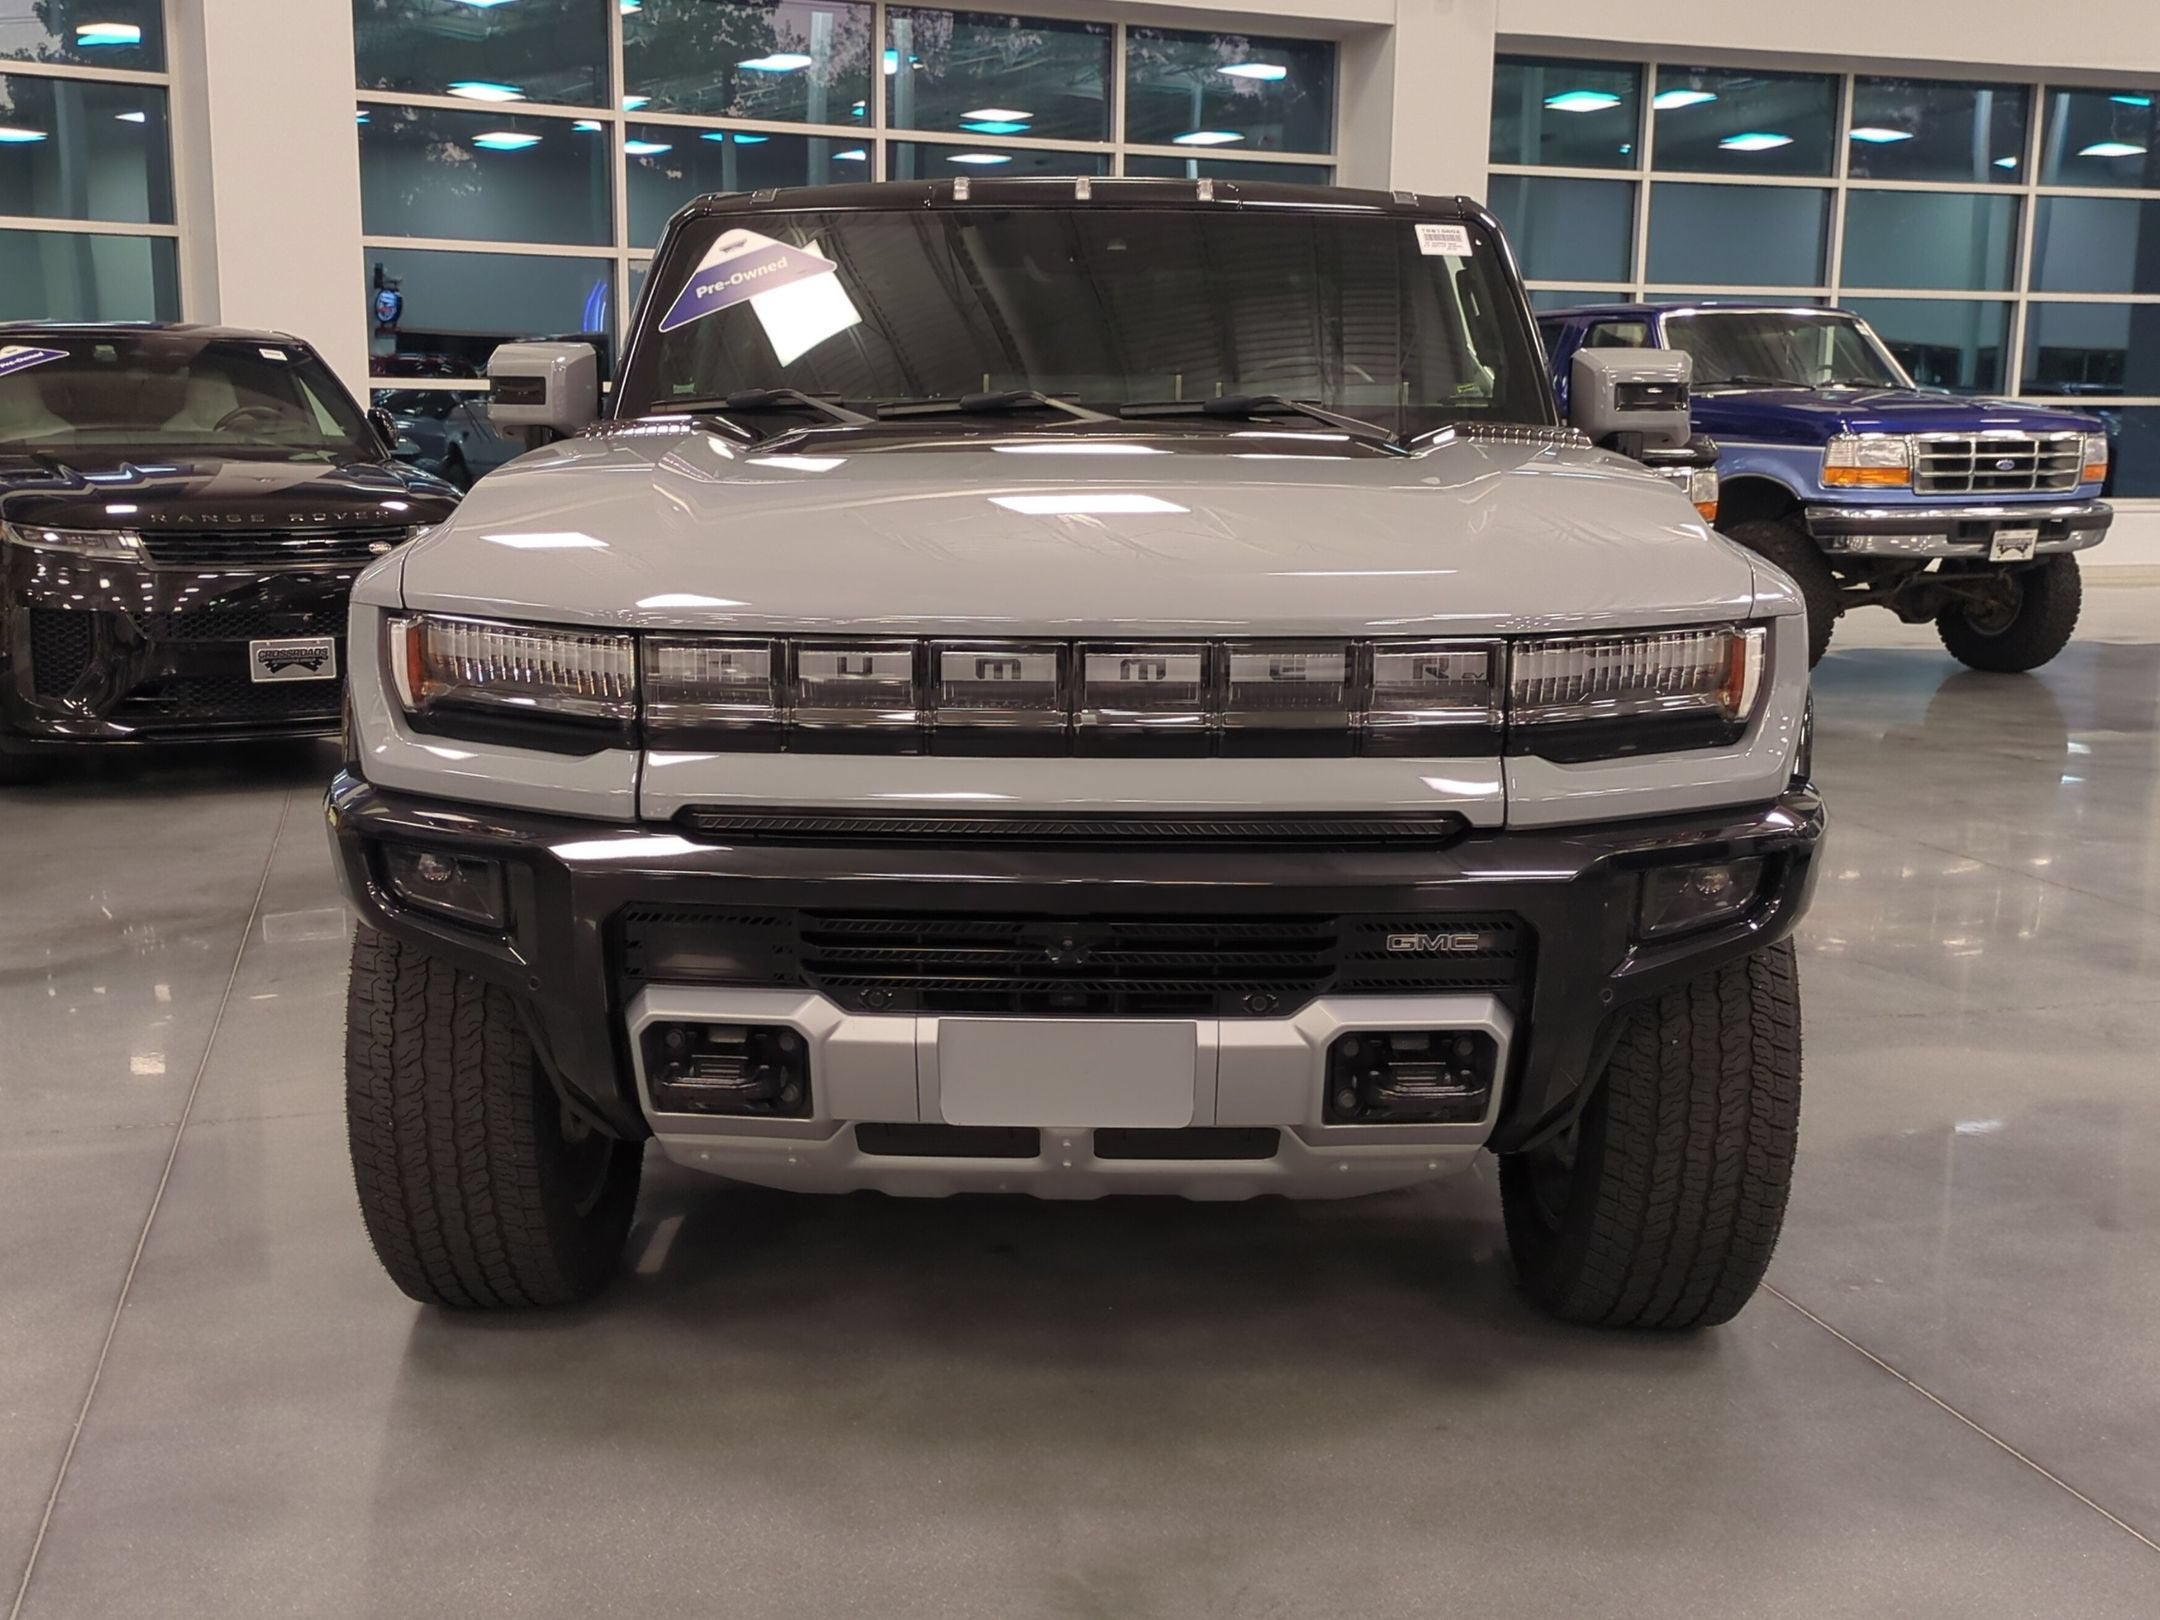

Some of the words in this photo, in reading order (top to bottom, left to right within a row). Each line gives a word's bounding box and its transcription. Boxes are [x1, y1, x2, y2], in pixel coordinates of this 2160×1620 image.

[696, 256, 789, 299] Pre-Owned
[151, 513, 265, 523] RANGE
[289, 510, 389, 522] ROVER
[257, 647, 329, 662] CROSSROADS
[1386, 933, 1479, 951] GMC
